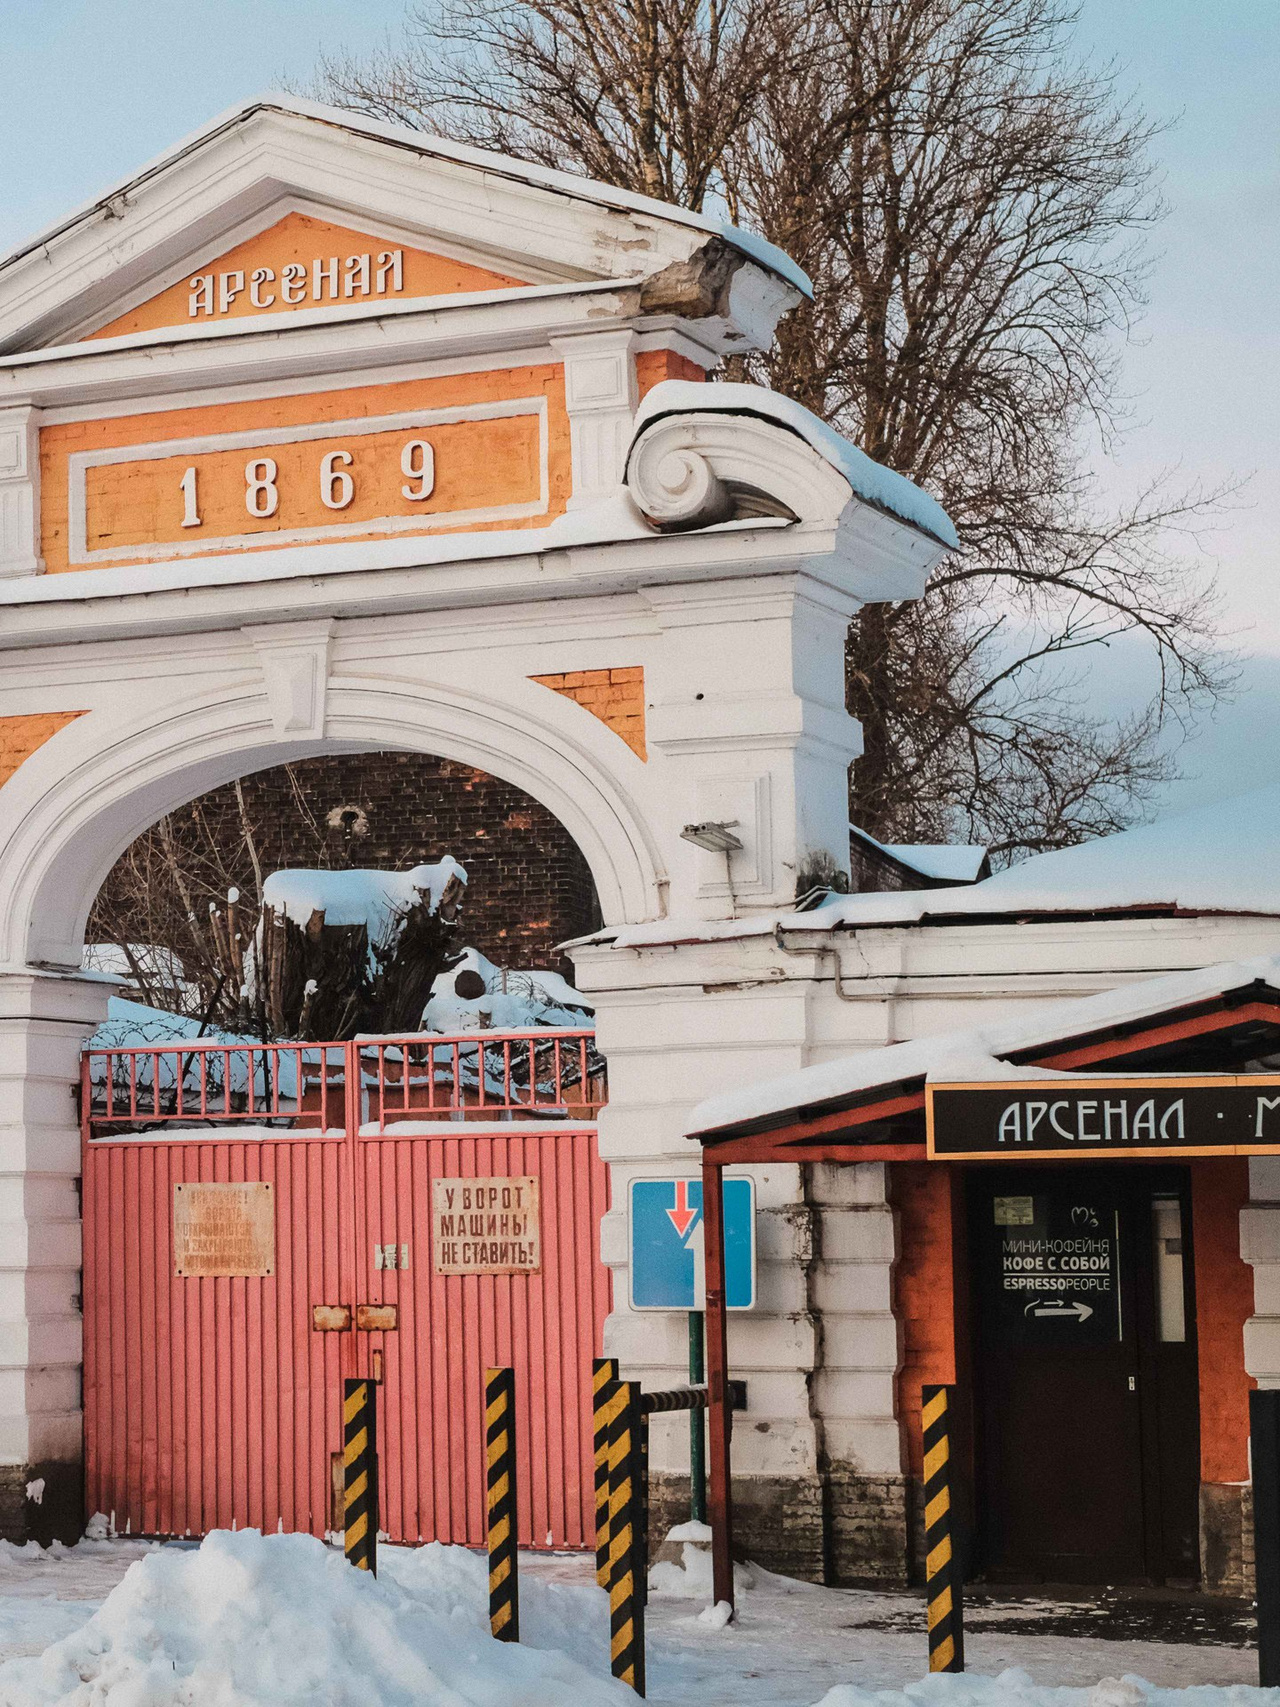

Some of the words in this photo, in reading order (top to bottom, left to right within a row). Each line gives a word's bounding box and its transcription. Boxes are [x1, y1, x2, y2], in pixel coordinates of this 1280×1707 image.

[189, 249, 404, 317] АРСЕНАЛ
[179, 440, 435, 528] 1869
[998, 1098, 1185, 1142] АРСЕНАЛ
[445, 1188, 455, 1209] У
[462, 1186, 523, 1209] ВОРОТ
[440, 1213, 527, 1236] МАШИНЫ
[441, 1242, 458, 1264] НЕ
[462, 1241, 535, 1264] СТАВИТЬ!
[1002, 1237, 1110, 1253] МИНИ-КОФЕЙНЯ
[1003, 1256, 1044, 1270] КОФЕ
[1047, 1256, 1057, 1270] С
[1060, 1253, 1110, 1270] СОБОЙ
[1003, 1278, 1111, 1291] ESPRESSOPEOPLE
